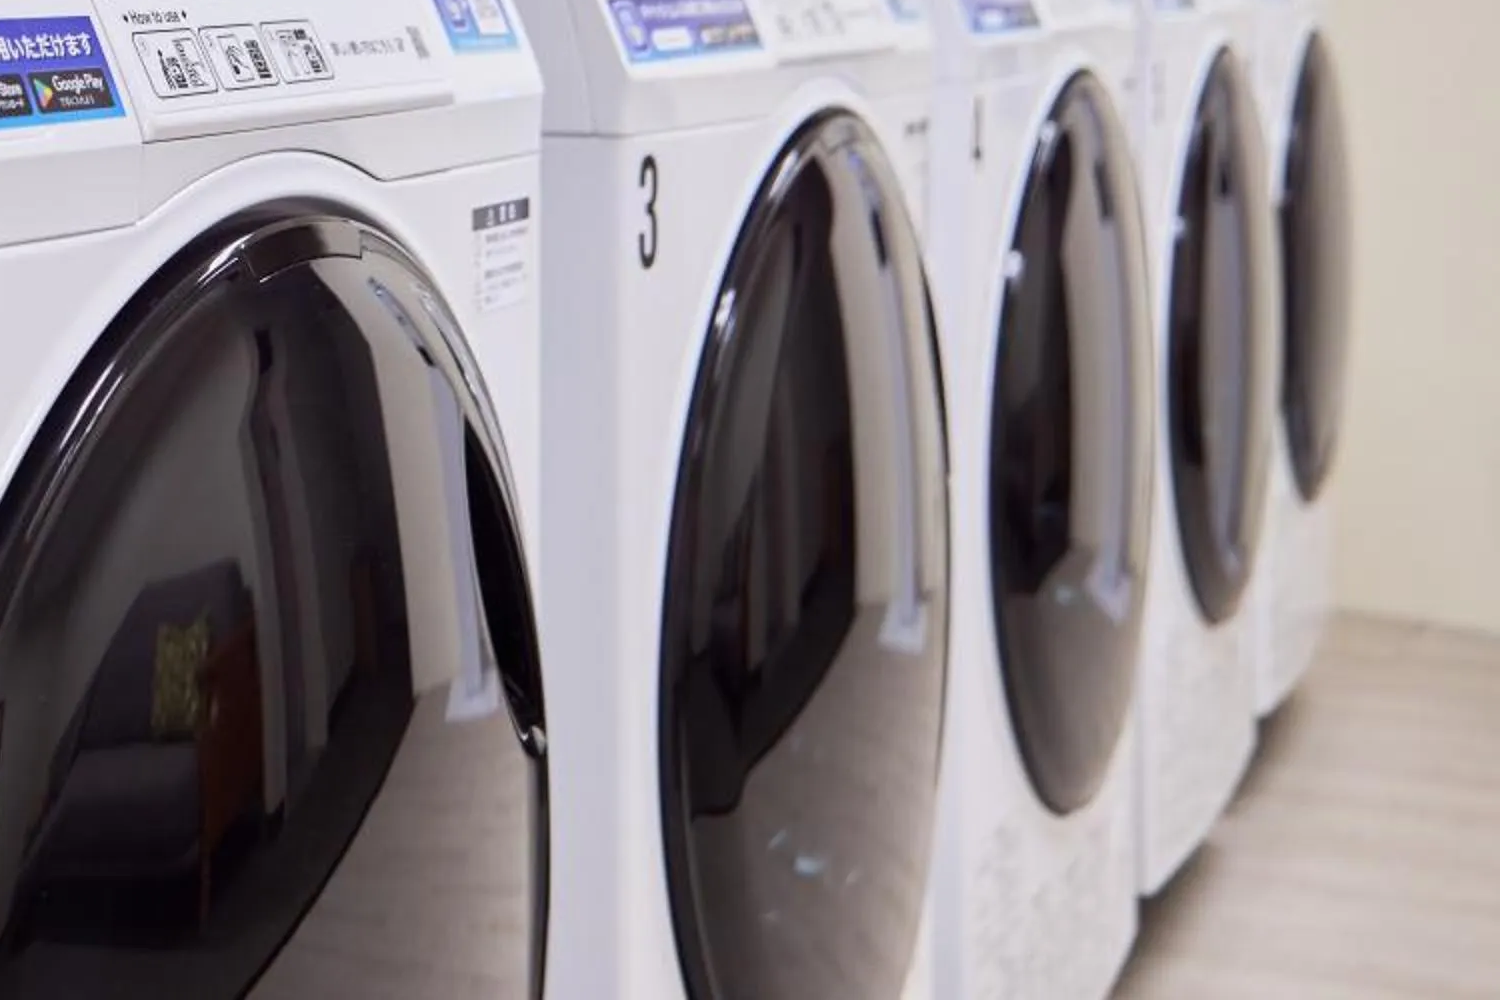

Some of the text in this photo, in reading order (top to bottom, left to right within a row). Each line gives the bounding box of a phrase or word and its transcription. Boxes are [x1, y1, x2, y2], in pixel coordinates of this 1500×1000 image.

[129, 10, 181, 24] How to use
[51, 72, 105, 94] Google Play
[639, 155, 658, 269] 3
